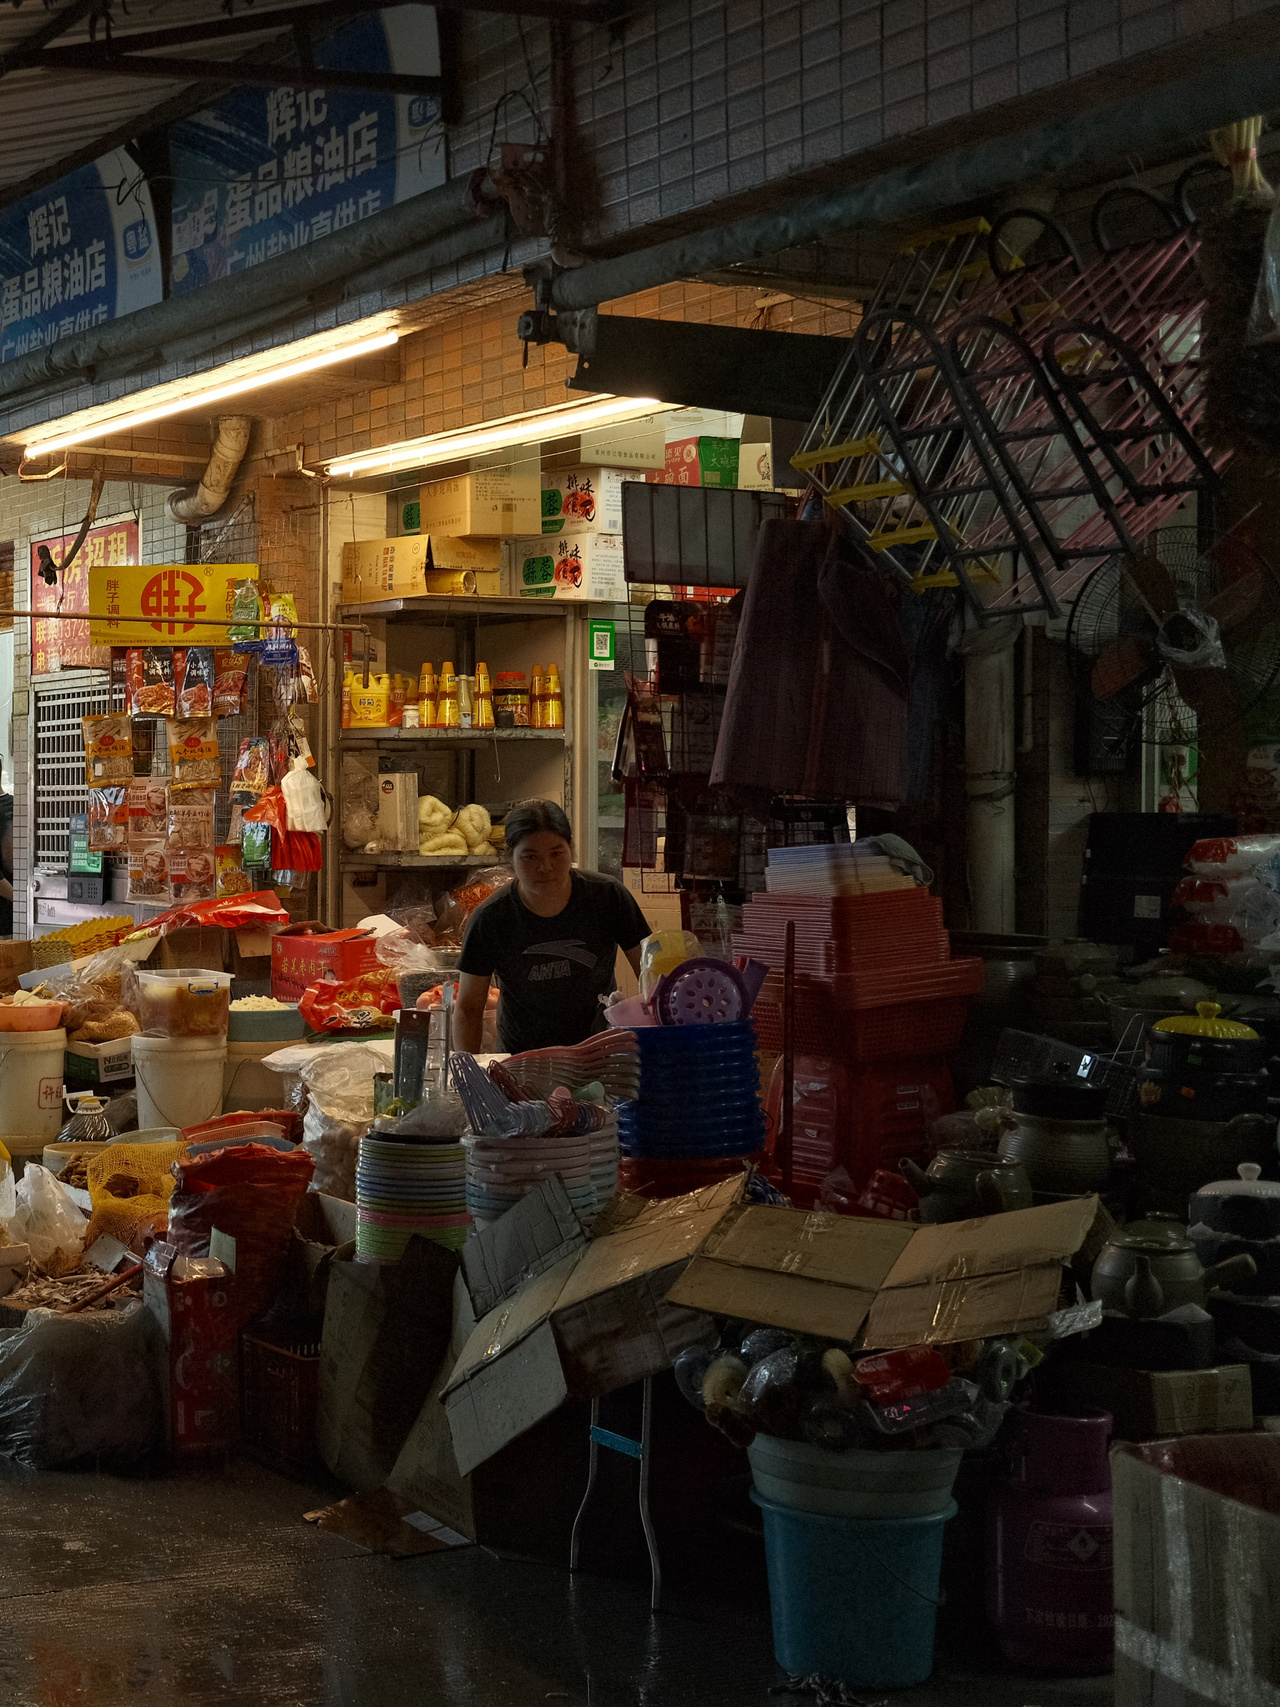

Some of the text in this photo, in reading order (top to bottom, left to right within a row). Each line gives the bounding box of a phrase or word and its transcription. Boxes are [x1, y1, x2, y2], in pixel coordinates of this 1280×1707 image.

[266, 86, 327, 148] 辉记
[224, 110, 378, 236] 蛋品粮油店
[28, 196, 71, 259] 辉记
[1, 239, 107, 328] 蛋品粮油店
[105, 579, 120, 629] 胖子调料
[528, 959, 572, 981] ANTA
